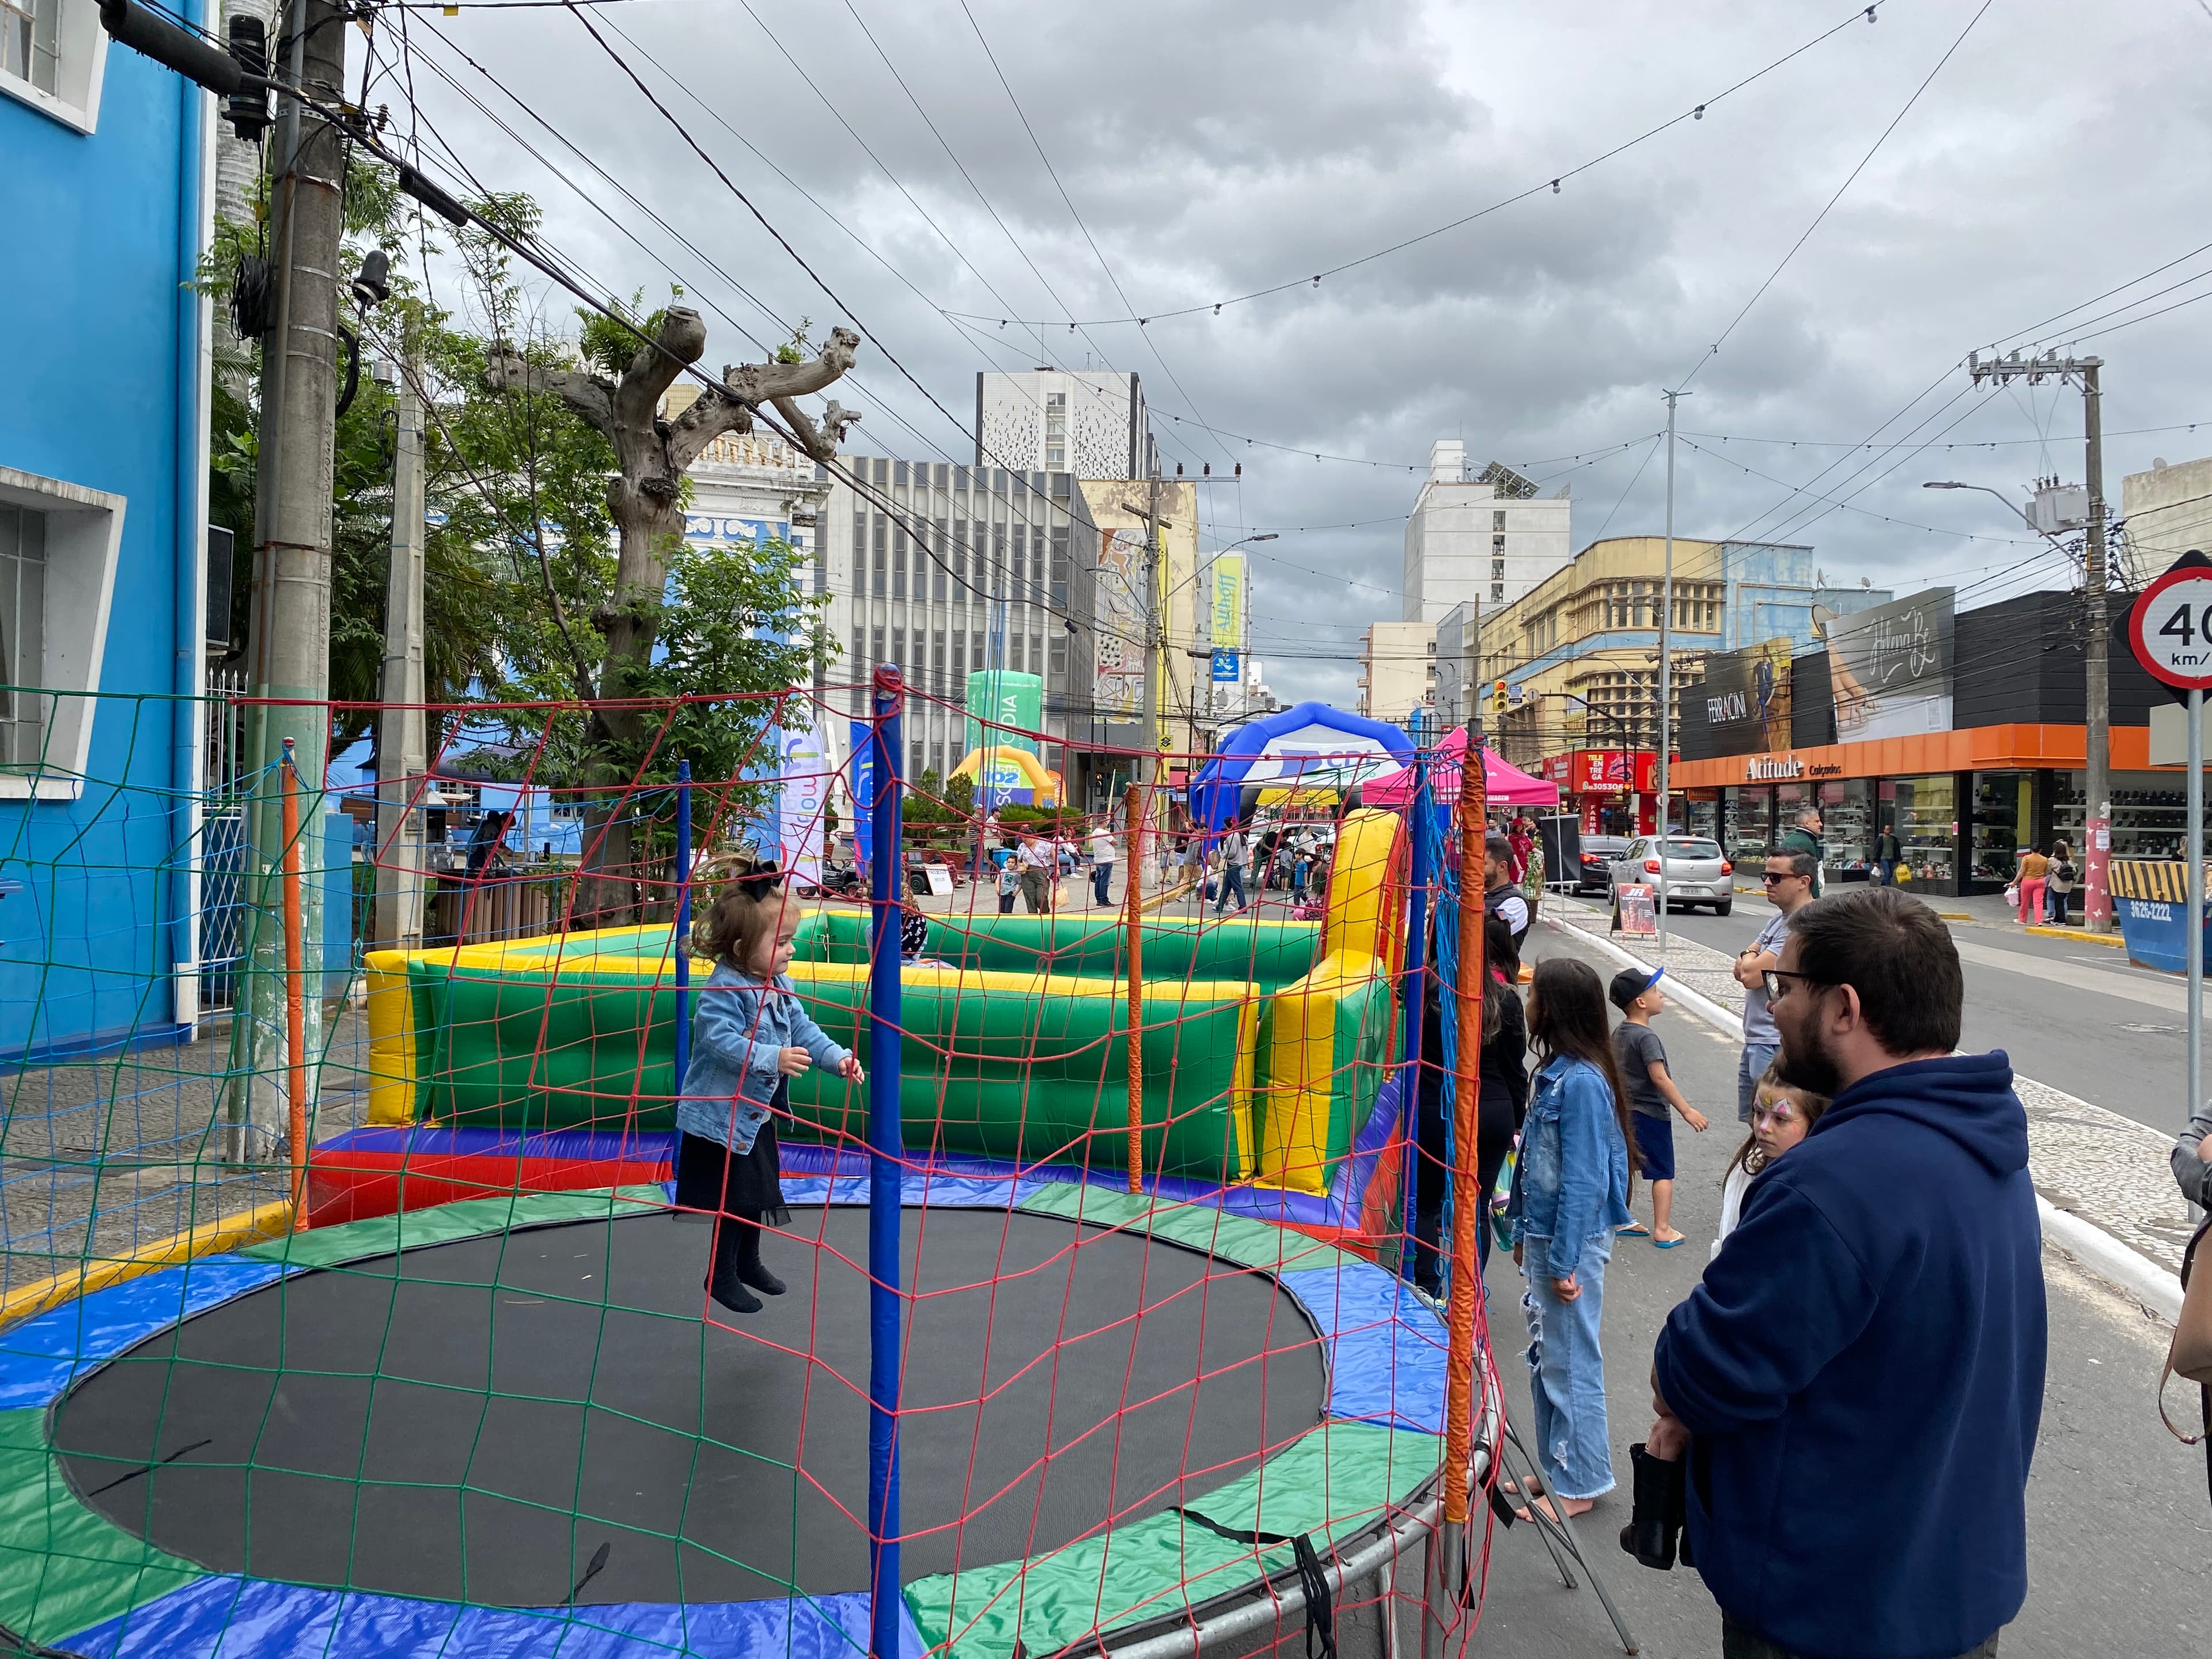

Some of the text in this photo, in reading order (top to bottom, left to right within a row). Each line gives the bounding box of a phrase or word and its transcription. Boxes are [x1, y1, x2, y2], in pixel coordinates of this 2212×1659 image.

[2172, 652, 2211, 665] km/
[1707, 691, 1747, 724] FERRACINI
[1330, 770, 1376, 779] barão
[1809, 764, 1842, 777] Calçados
[984, 771, 1019, 784] 102
[1593, 783, 1634, 791] 305306
[1626, 888, 1645, 896] JR
[2130, 900, 2172, 922] 3626-2222
